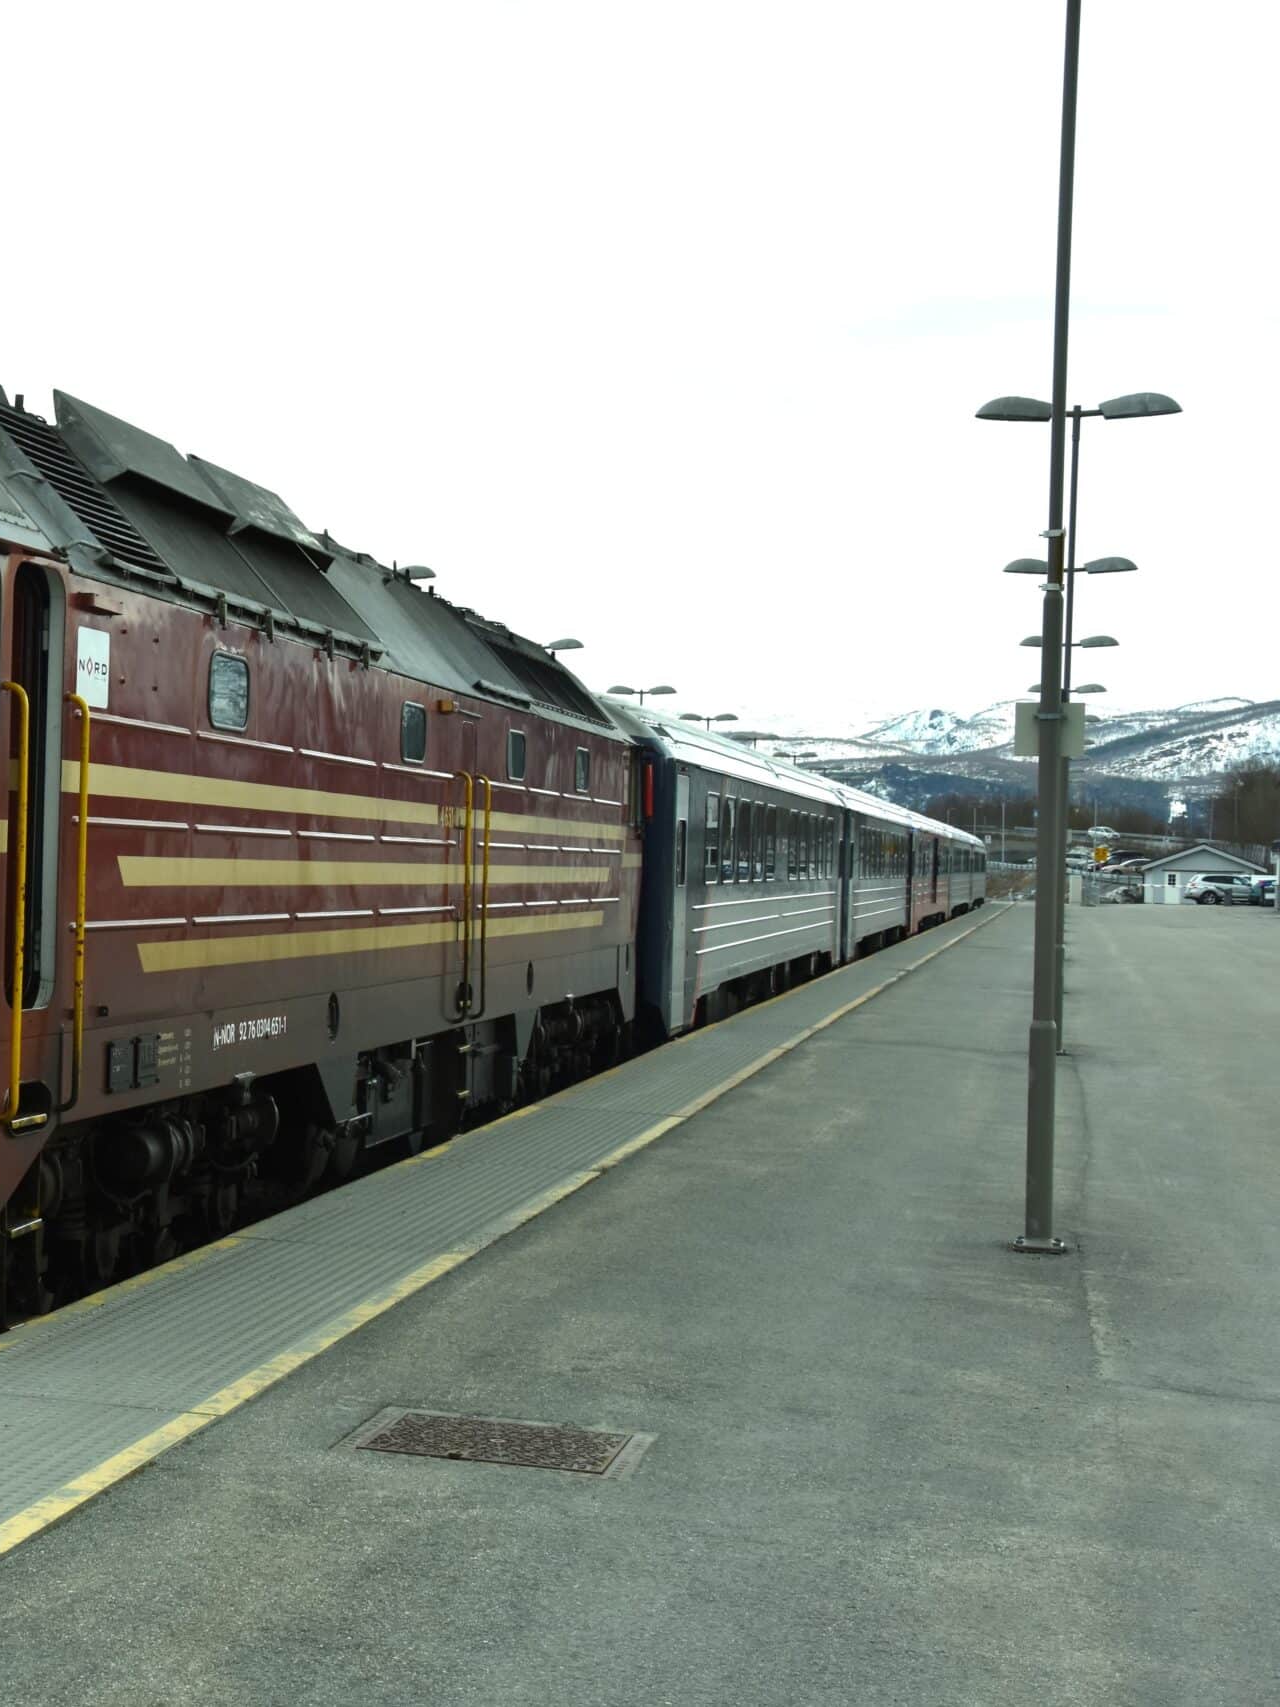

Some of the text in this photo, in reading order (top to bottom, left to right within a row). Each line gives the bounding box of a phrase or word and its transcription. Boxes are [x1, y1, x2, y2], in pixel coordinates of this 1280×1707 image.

[79, 656, 108, 676] NORD
[239, 1021, 247, 1041] 92
[247, 1020, 257, 1039] 76
